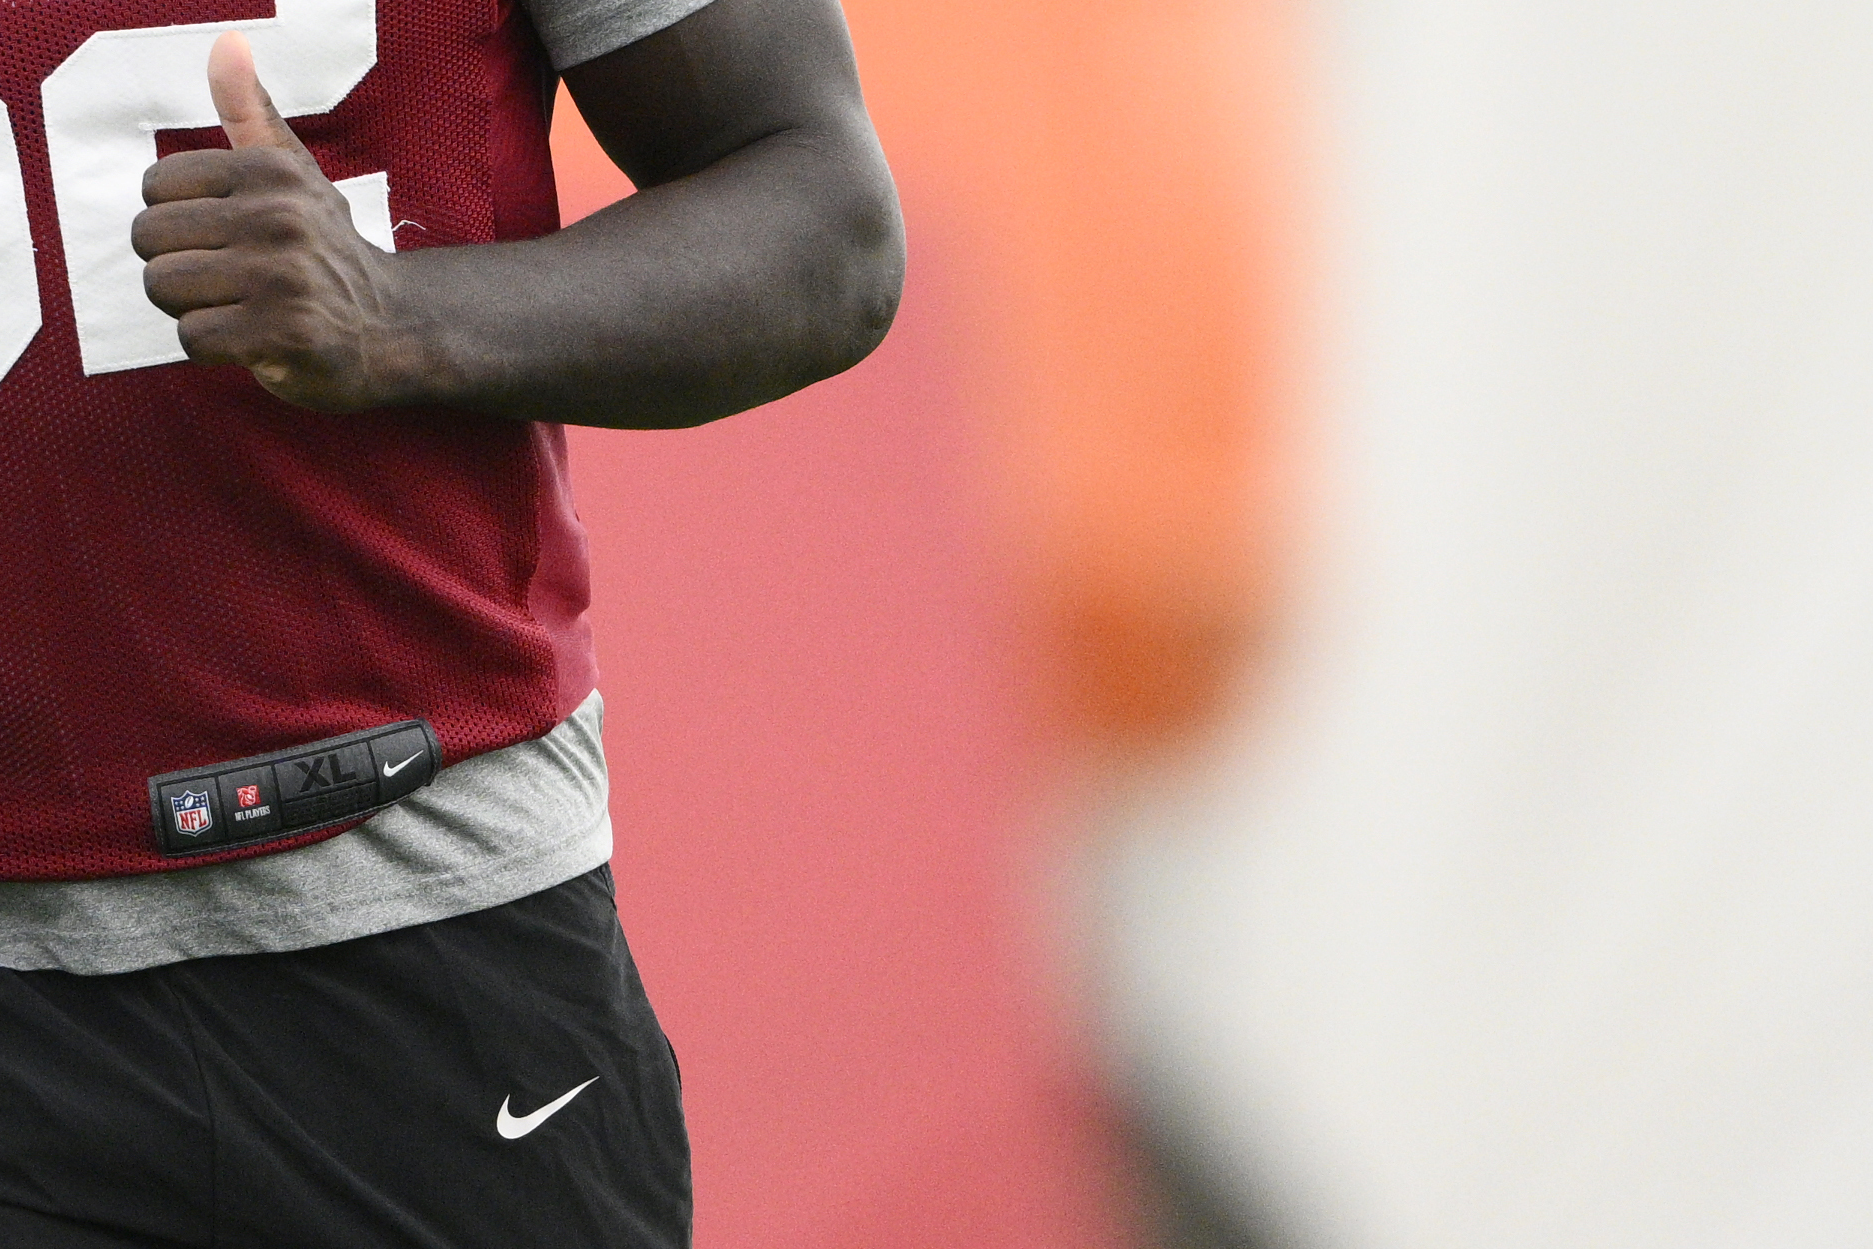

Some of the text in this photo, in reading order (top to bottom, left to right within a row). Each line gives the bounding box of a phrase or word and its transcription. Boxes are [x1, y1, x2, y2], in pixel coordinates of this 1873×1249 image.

[294, 753, 357, 792] XL
[179, 809, 208, 830] NFL
[244, 805, 271, 820] PLAYERS
